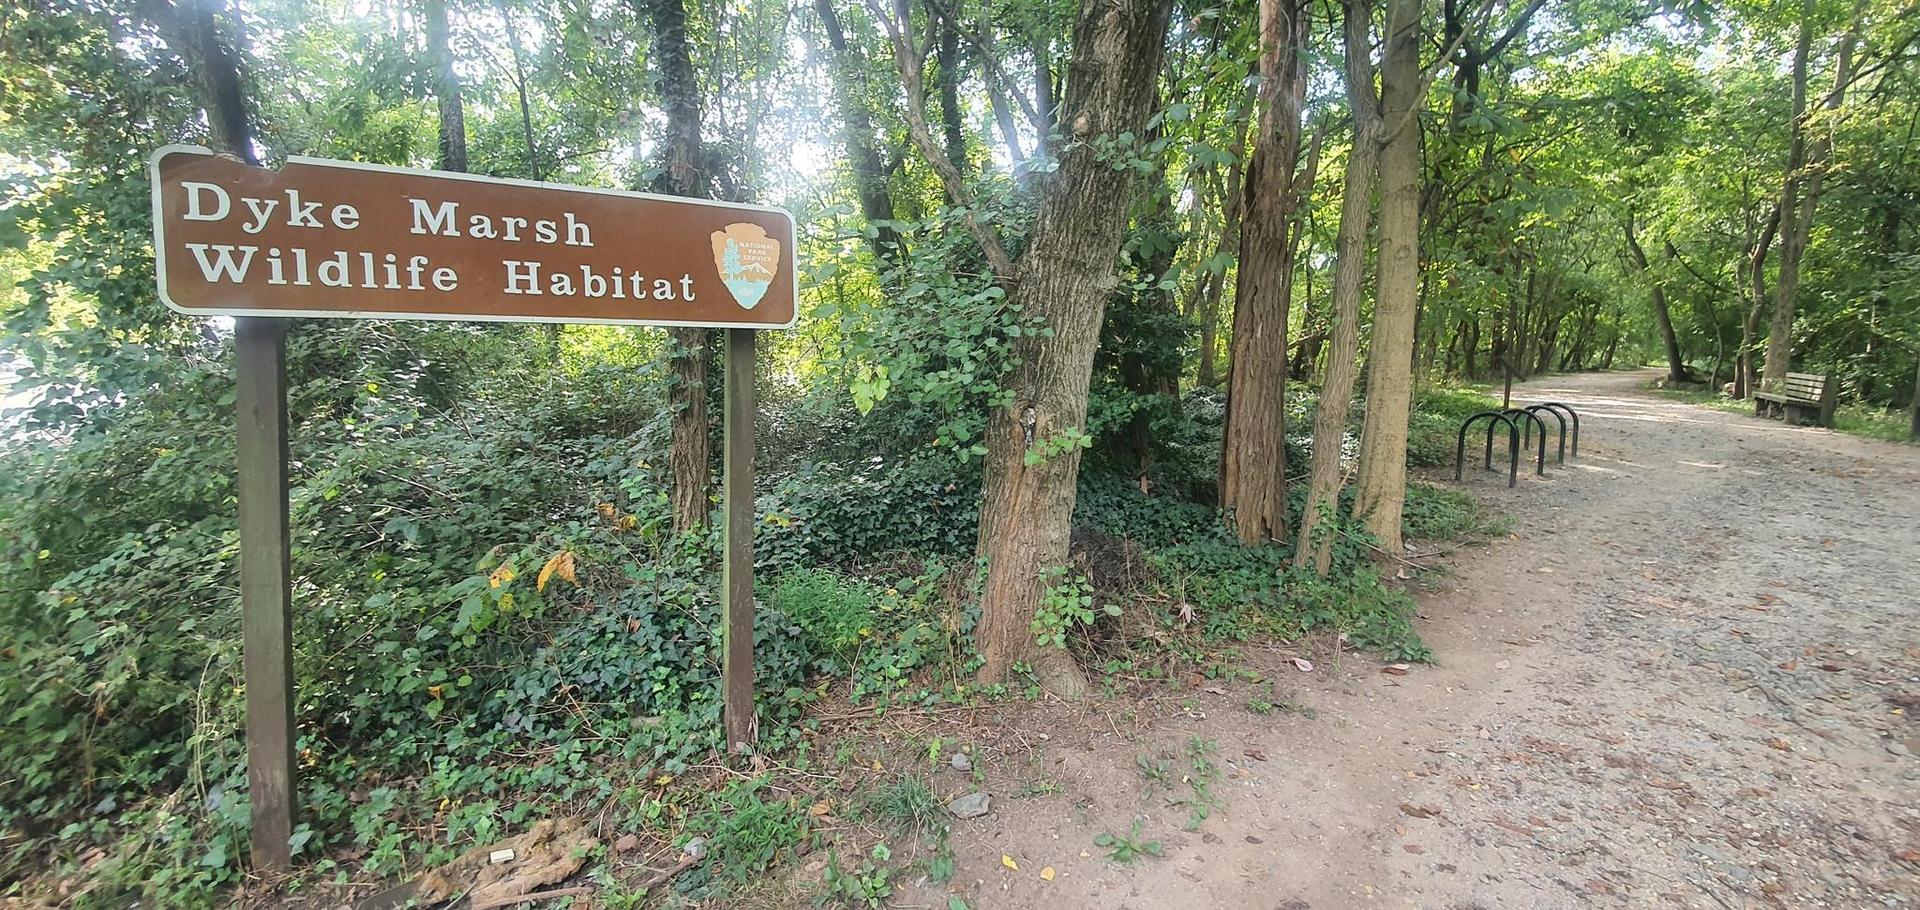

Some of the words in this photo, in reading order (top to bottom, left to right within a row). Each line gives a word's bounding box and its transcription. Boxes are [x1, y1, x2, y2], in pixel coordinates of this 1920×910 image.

[181, 181, 360, 234] Dyke
[409, 198, 594, 247] Marsh
[185, 243, 459, 292] Wildlife
[502, 260, 696, 302] Habitat
